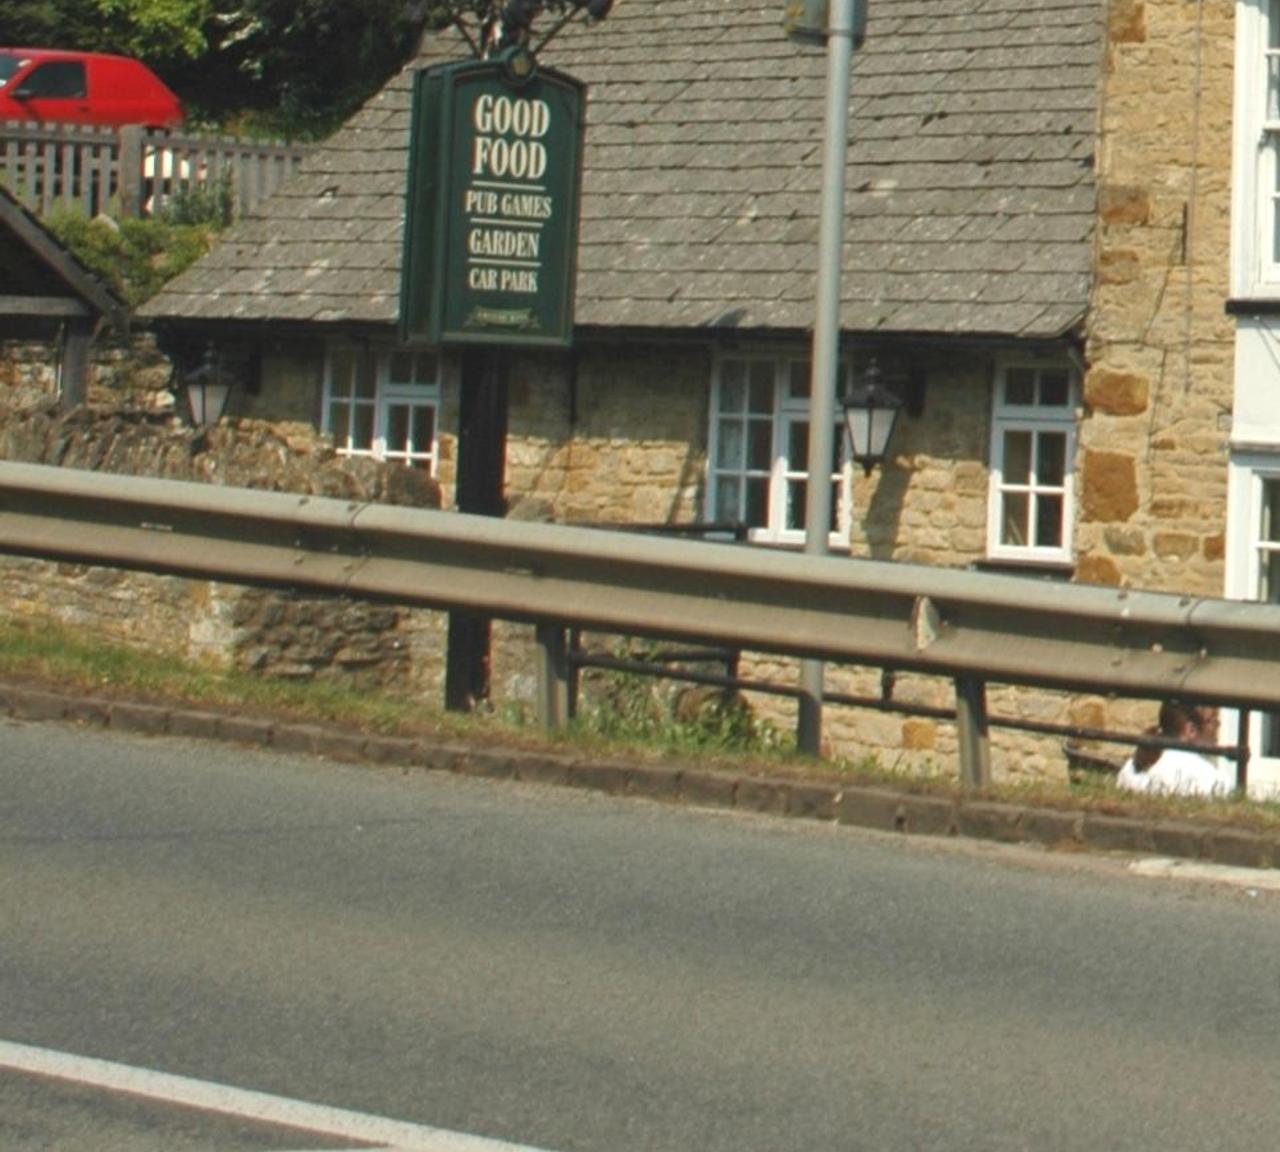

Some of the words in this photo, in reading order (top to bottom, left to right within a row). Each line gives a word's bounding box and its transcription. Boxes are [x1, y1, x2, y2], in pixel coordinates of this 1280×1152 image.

[475, 94, 551, 138] GOOD
[472, 137, 547, 179] FOOD
[465, 190, 497, 215] PUB
[501, 194, 553, 219] GAMES
[469, 228, 540, 258] GARDEN
[469, 268, 498, 291] CAR
[501, 270, 538, 293] PARK
